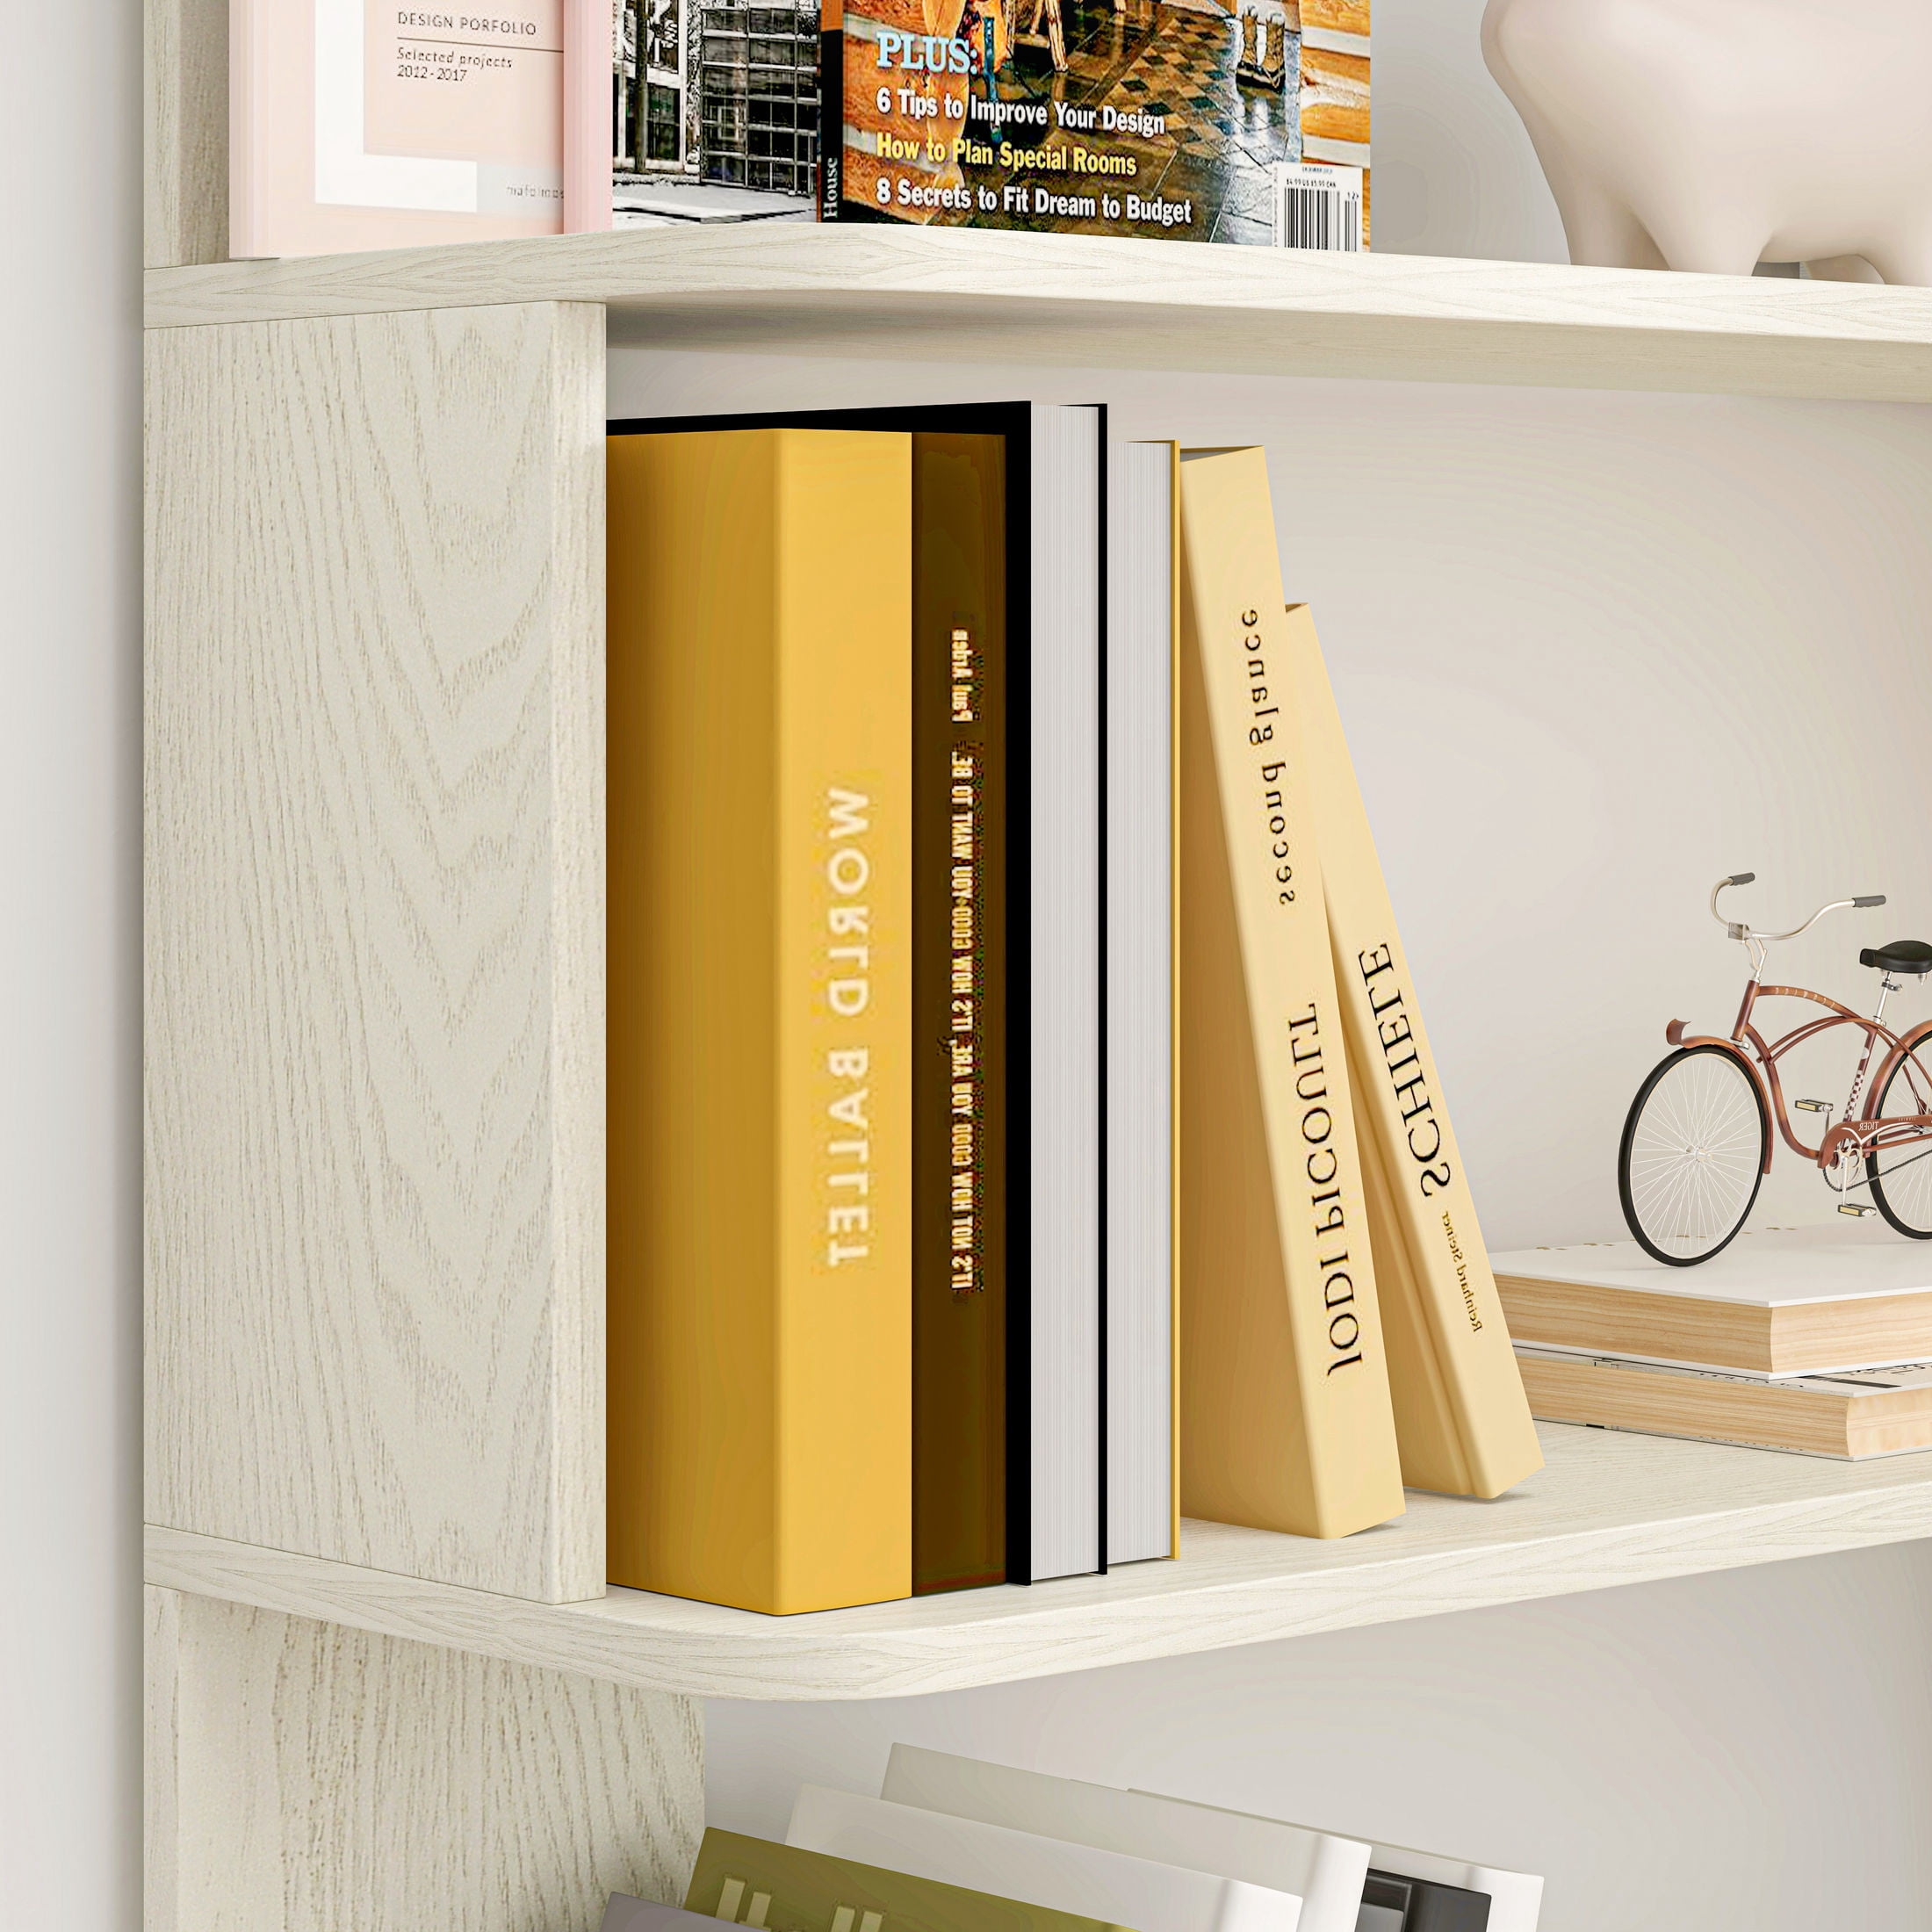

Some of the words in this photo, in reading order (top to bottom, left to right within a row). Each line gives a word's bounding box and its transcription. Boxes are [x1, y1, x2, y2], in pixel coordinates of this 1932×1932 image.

[397, 11, 453, 28] DESIGN
[460, 17, 537, 36] PORFOLIO
[396, 47, 454, 63] Selected
[459, 54, 513, 70] projects
[876, 31, 977, 75] PLUS:
[876, 86, 891, 113] 6
[898, 89, 939, 119] Tips
[944, 92, 963, 119] to
[970, 95, 1048, 126] Improve
[1055, 101, 1097, 129] Your
[1103, 105, 1165, 138] Design
[876, 132, 919, 160] How
[926, 135, 946, 162] to
[953, 138, 993, 165] Plan
[999, 141, 1067, 172] Special
[1073, 147, 1136, 176] Rooms
[822, 157, 839, 220] House
[876, 177, 891, 205] 8
[898, 178, 972, 209] Secrets
[977, 185, 998, 211] to
[1003, 185, 1029, 213] Fit
[1035, 188, 1096, 217] Dream
[1102, 193, 1121, 219] to
[1127, 194, 1192, 227] Budget
